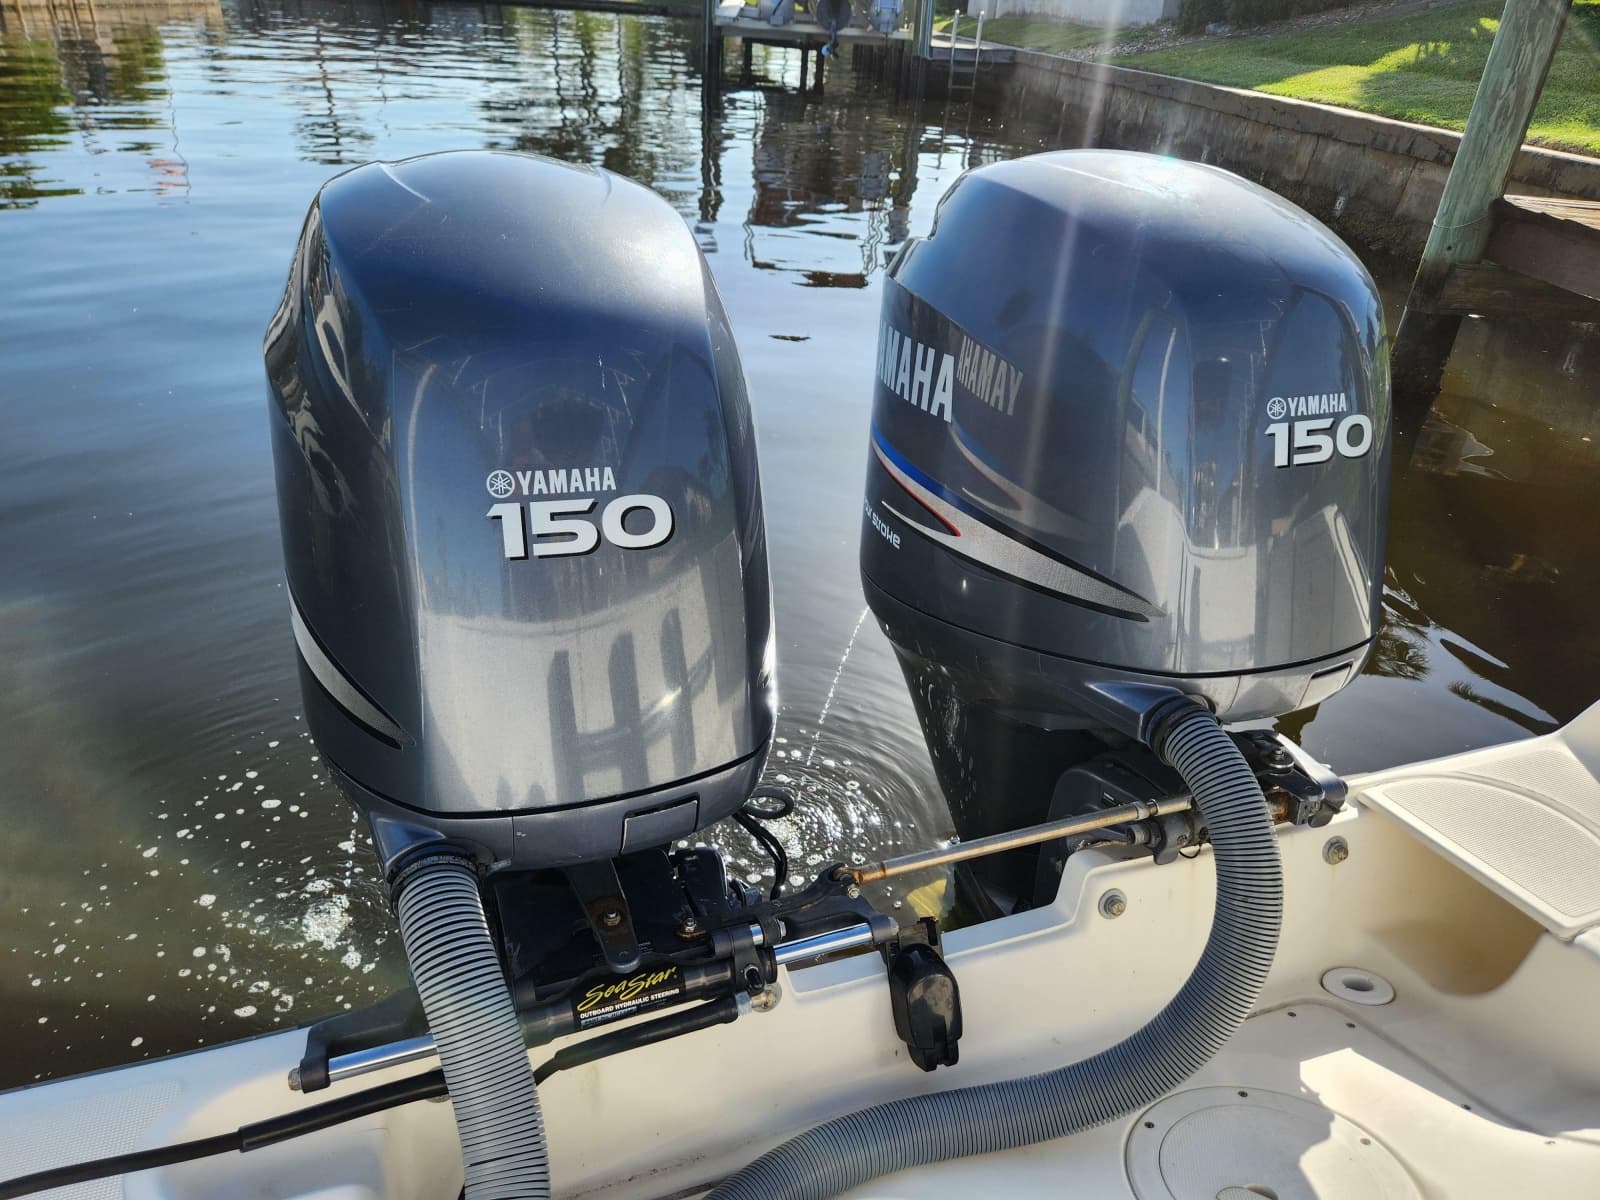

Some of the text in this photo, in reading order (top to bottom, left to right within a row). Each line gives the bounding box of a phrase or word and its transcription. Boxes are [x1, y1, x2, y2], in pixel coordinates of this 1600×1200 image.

[877, 319, 955, 424] AMAHA
[1287, 393, 1347, 417] YAMAHA
[1264, 414, 1373, 468] 150
[516, 466, 617, 496] YAMAHA
[486, 494, 675, 560] 150
[577, 966, 677, 1011] SeaStar
[580, 1005, 614, 1019] OUTBOARD
[615, 996, 650, 1010] HYDRAULIC
[651, 988, 680, 1001] STEERING
